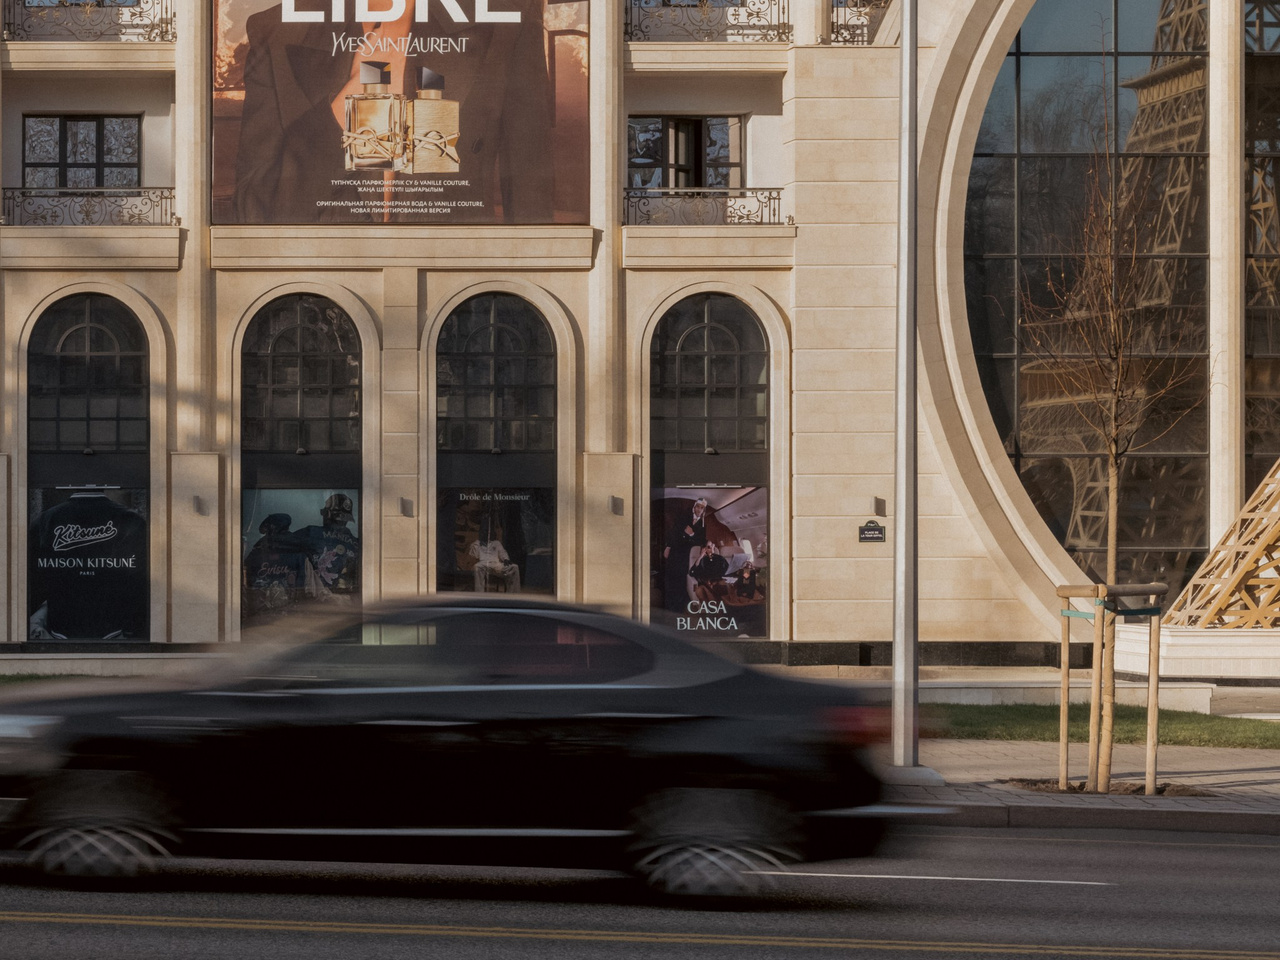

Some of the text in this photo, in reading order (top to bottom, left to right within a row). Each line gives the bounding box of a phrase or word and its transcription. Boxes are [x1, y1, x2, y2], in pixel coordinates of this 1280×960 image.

[420, 179, 442, 187] VANILLE
[459, 493, 530, 501] Drôle de Monsieur
[52, 520, 118, 551] Kitsuné
[37, 554, 136, 568] MAISON KITSUNÉ
[687, 600, 727, 615] CASA
[676, 617, 738, 631] BLANCA
